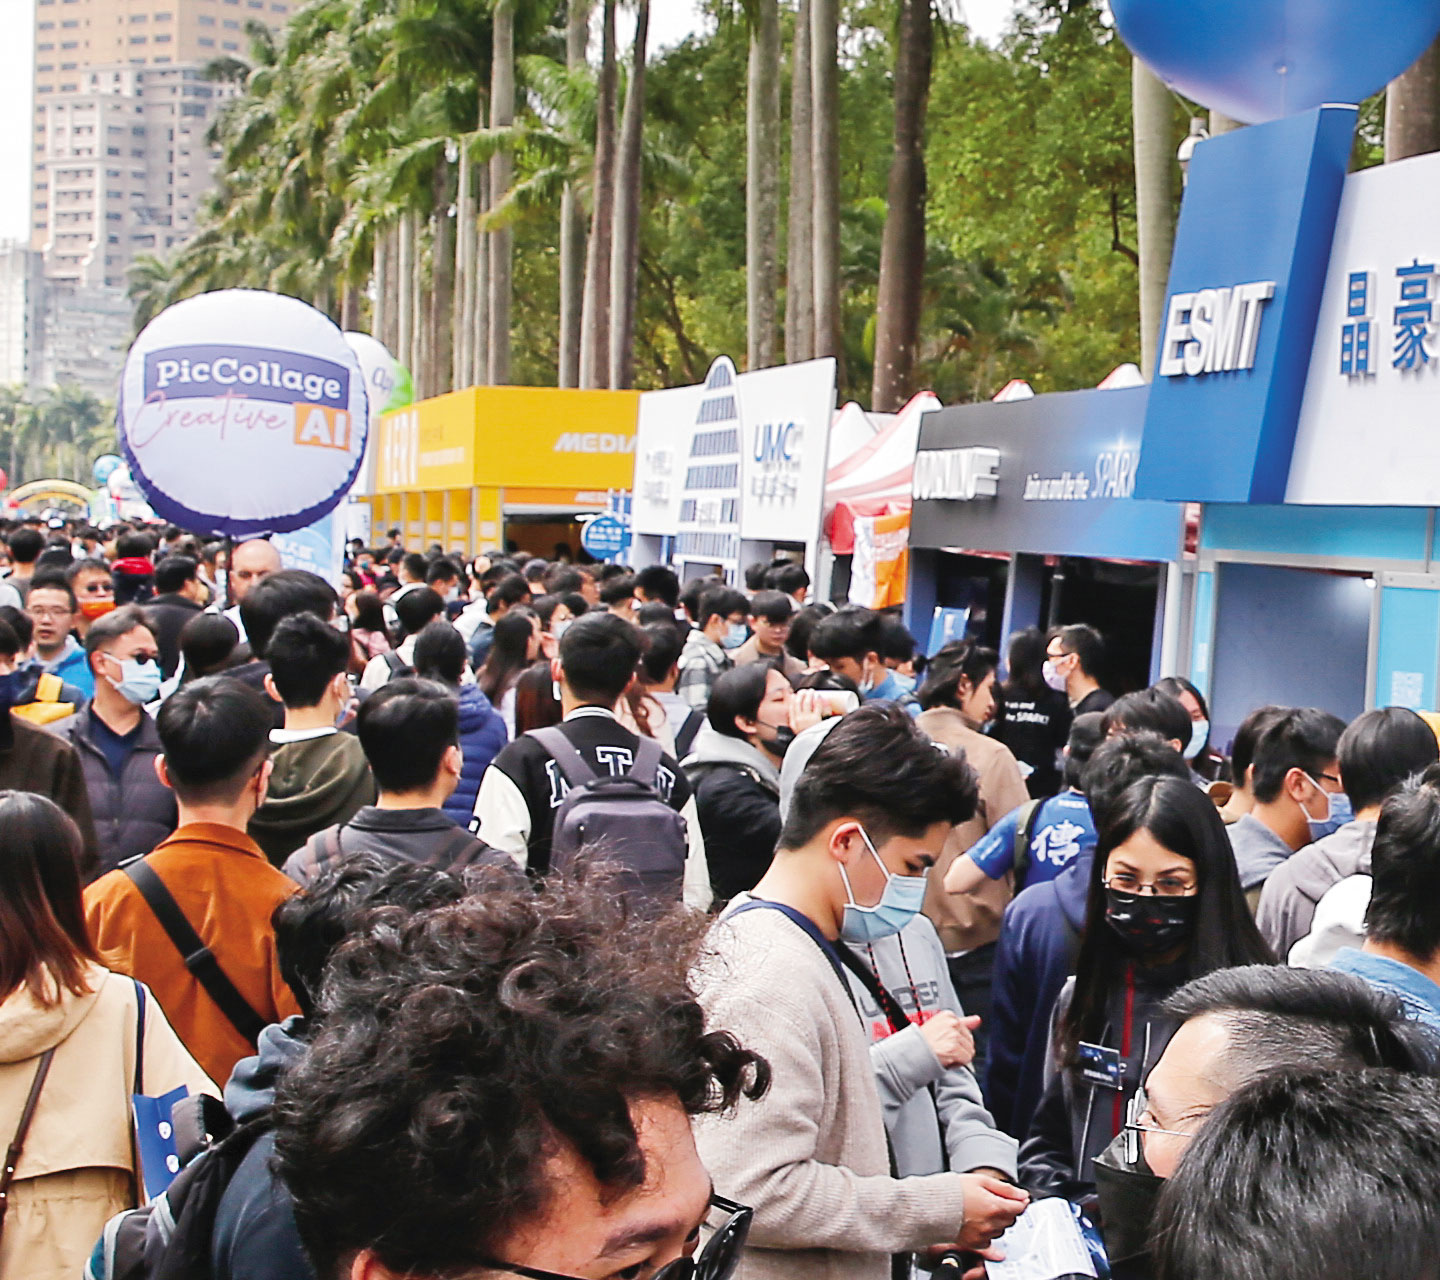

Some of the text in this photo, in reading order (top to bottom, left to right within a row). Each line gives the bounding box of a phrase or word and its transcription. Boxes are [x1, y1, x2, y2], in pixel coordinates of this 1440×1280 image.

[1159, 280, 1276, 377] ESMT
[156, 357, 342, 401] PicCollage
[130, 387, 347, 449] Creative AI
[754, 422, 796, 462] UMC
